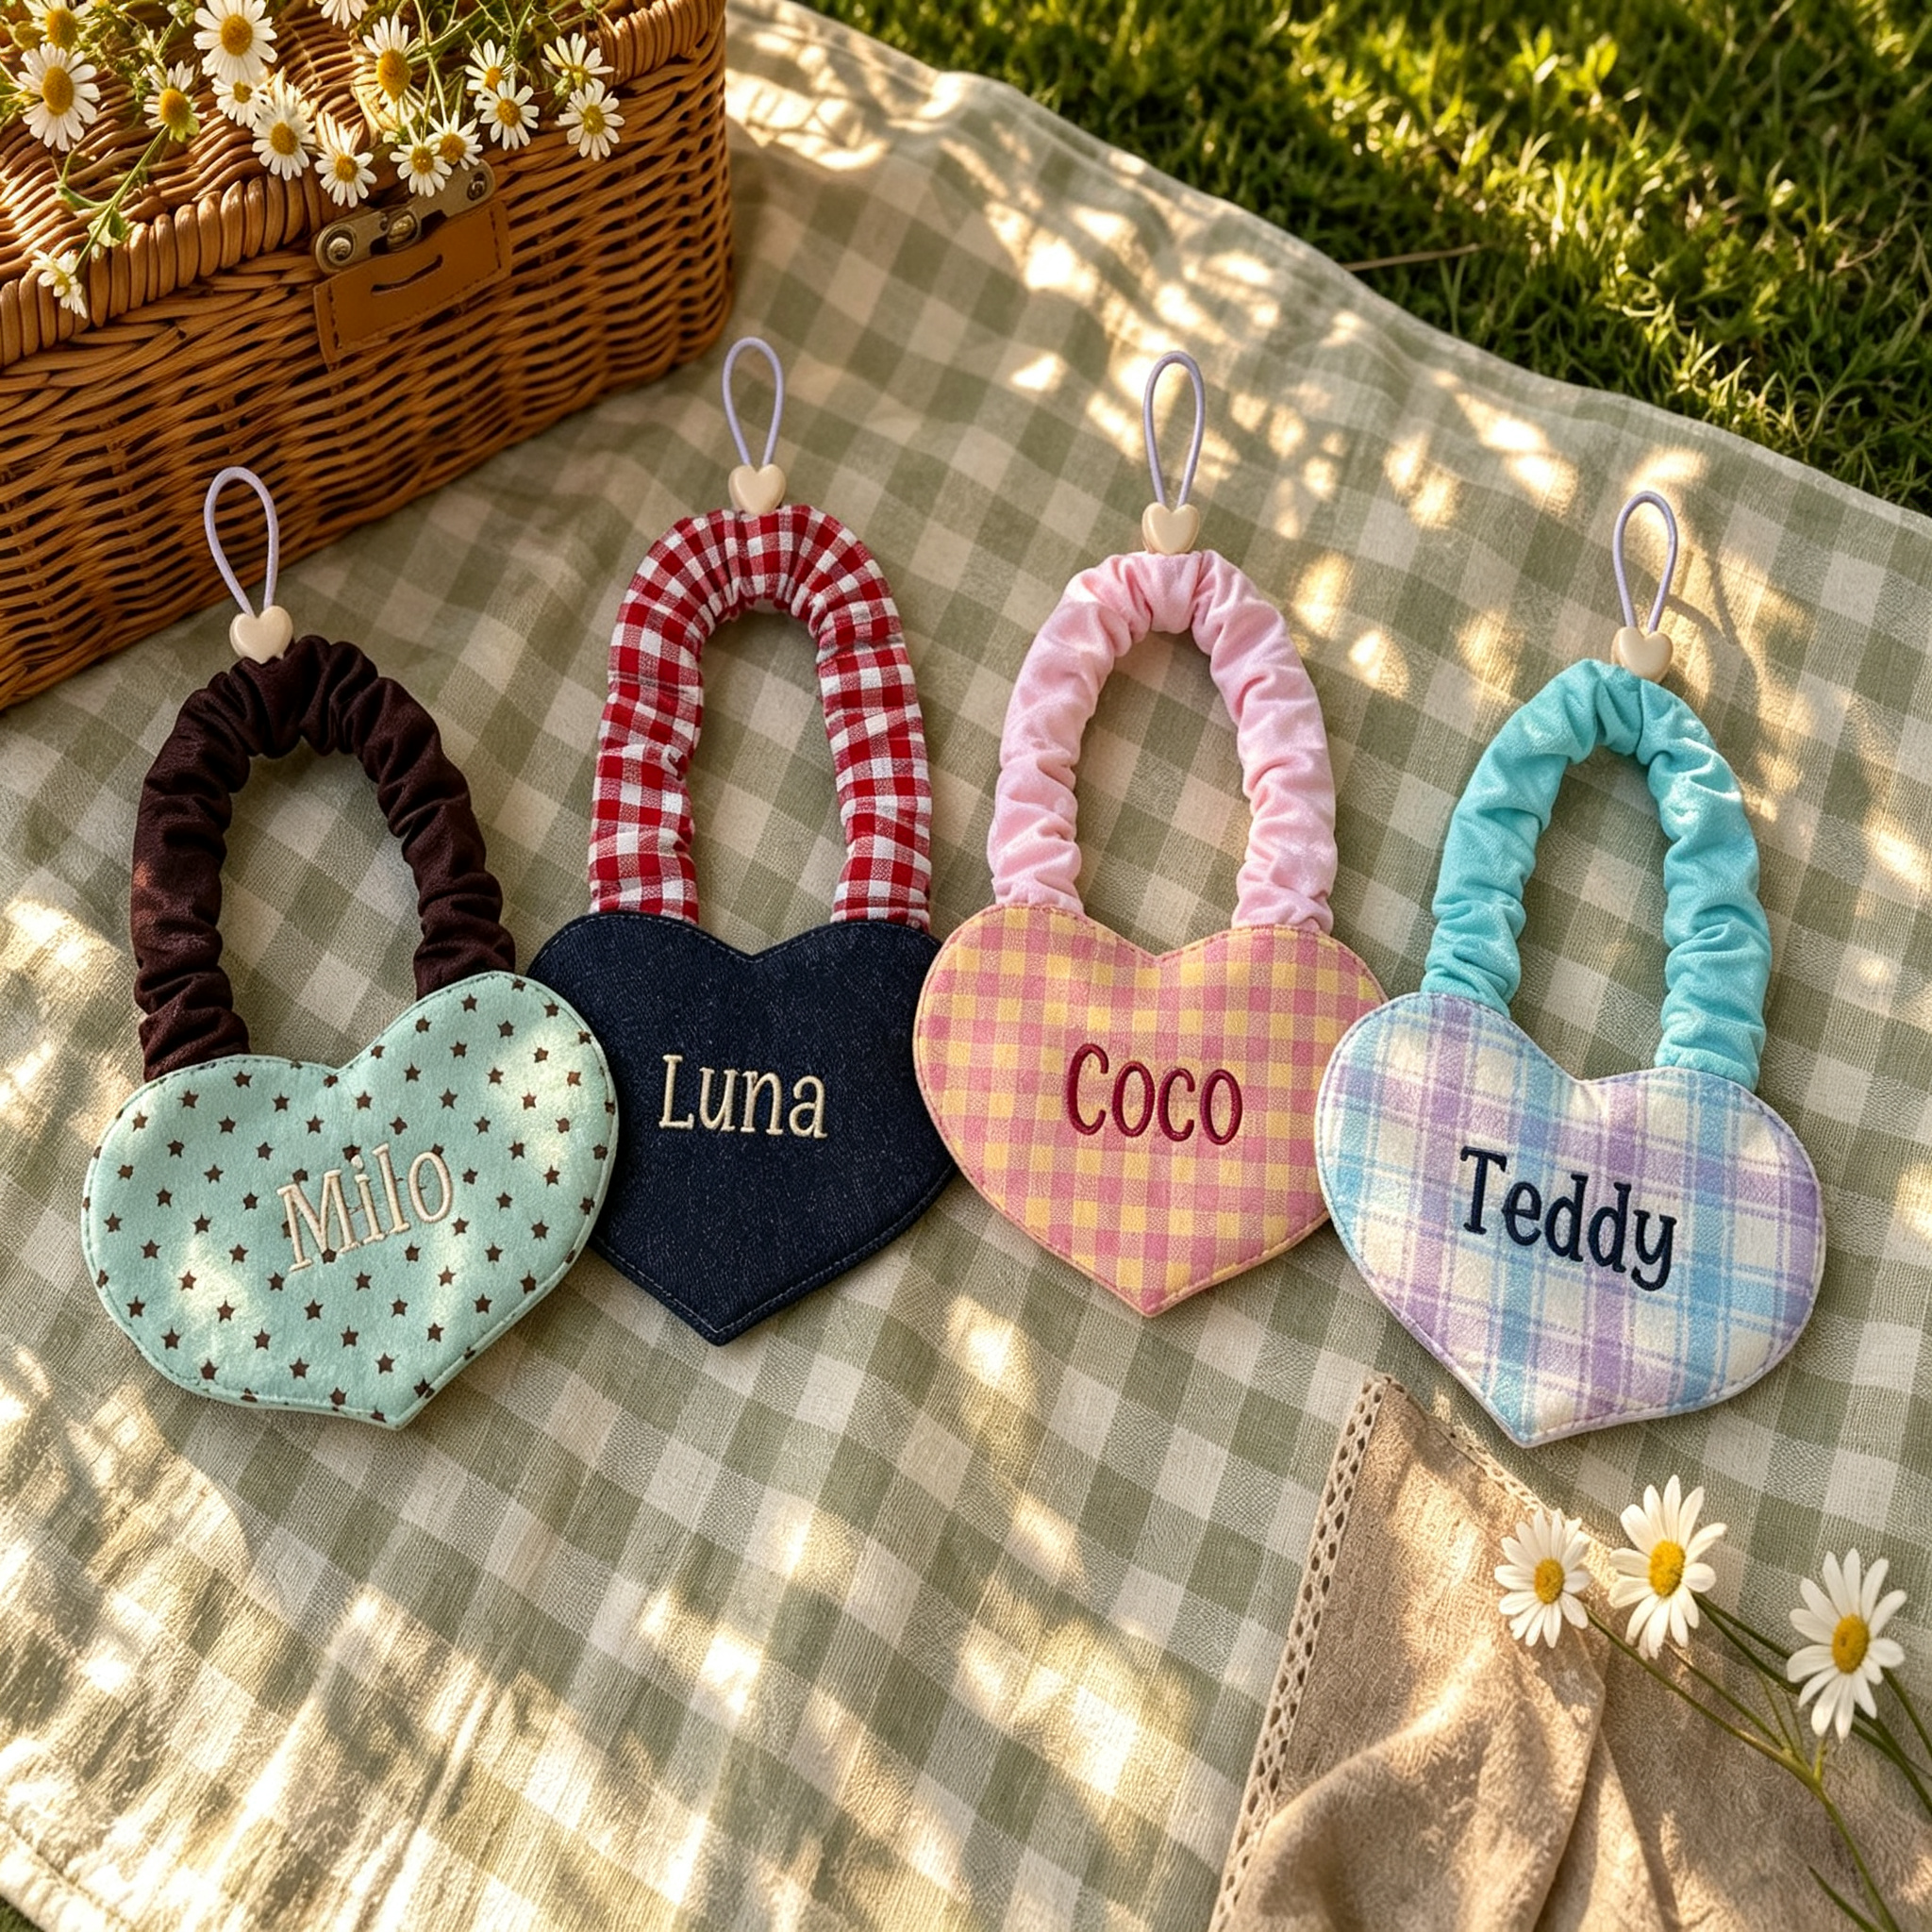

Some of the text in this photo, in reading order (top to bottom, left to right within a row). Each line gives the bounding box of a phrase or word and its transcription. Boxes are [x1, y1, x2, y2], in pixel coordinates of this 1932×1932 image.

[658, 1054, 828, 1139] Luna
[1066, 1042, 1243, 1146] Coco
[276, 1142, 453, 1272] Milo
[1460, 1145, 1677, 1291] Teddy
